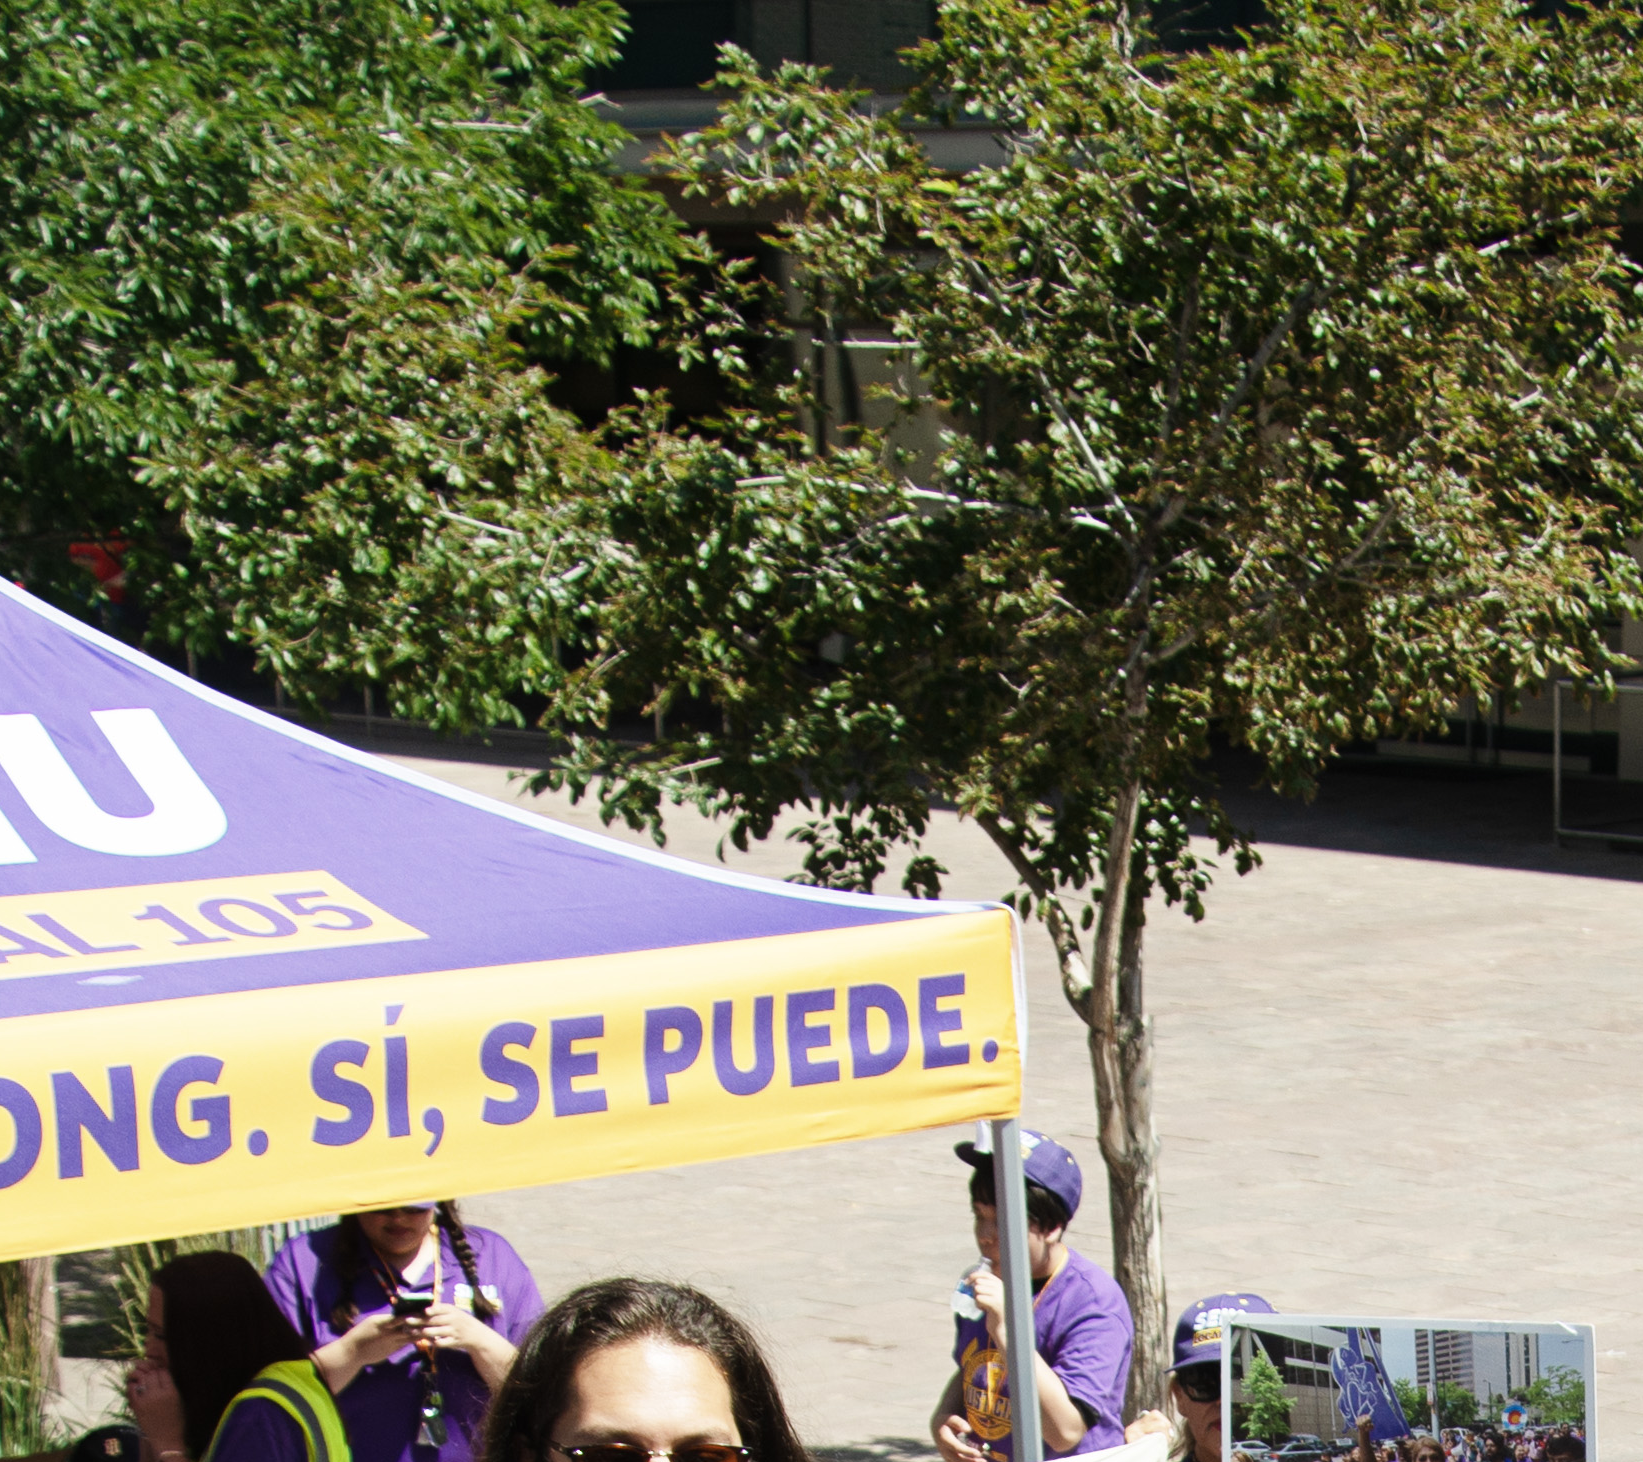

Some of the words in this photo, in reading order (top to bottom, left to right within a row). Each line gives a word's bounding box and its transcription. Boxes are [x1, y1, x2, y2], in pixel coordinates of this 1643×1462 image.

[129, 889, 374, 949] 105
[309, 1003, 445, 1160] SÍ,
[478, 1013, 607, 1125] SE
[643, 971, 1001, 1107] PUEDE.
